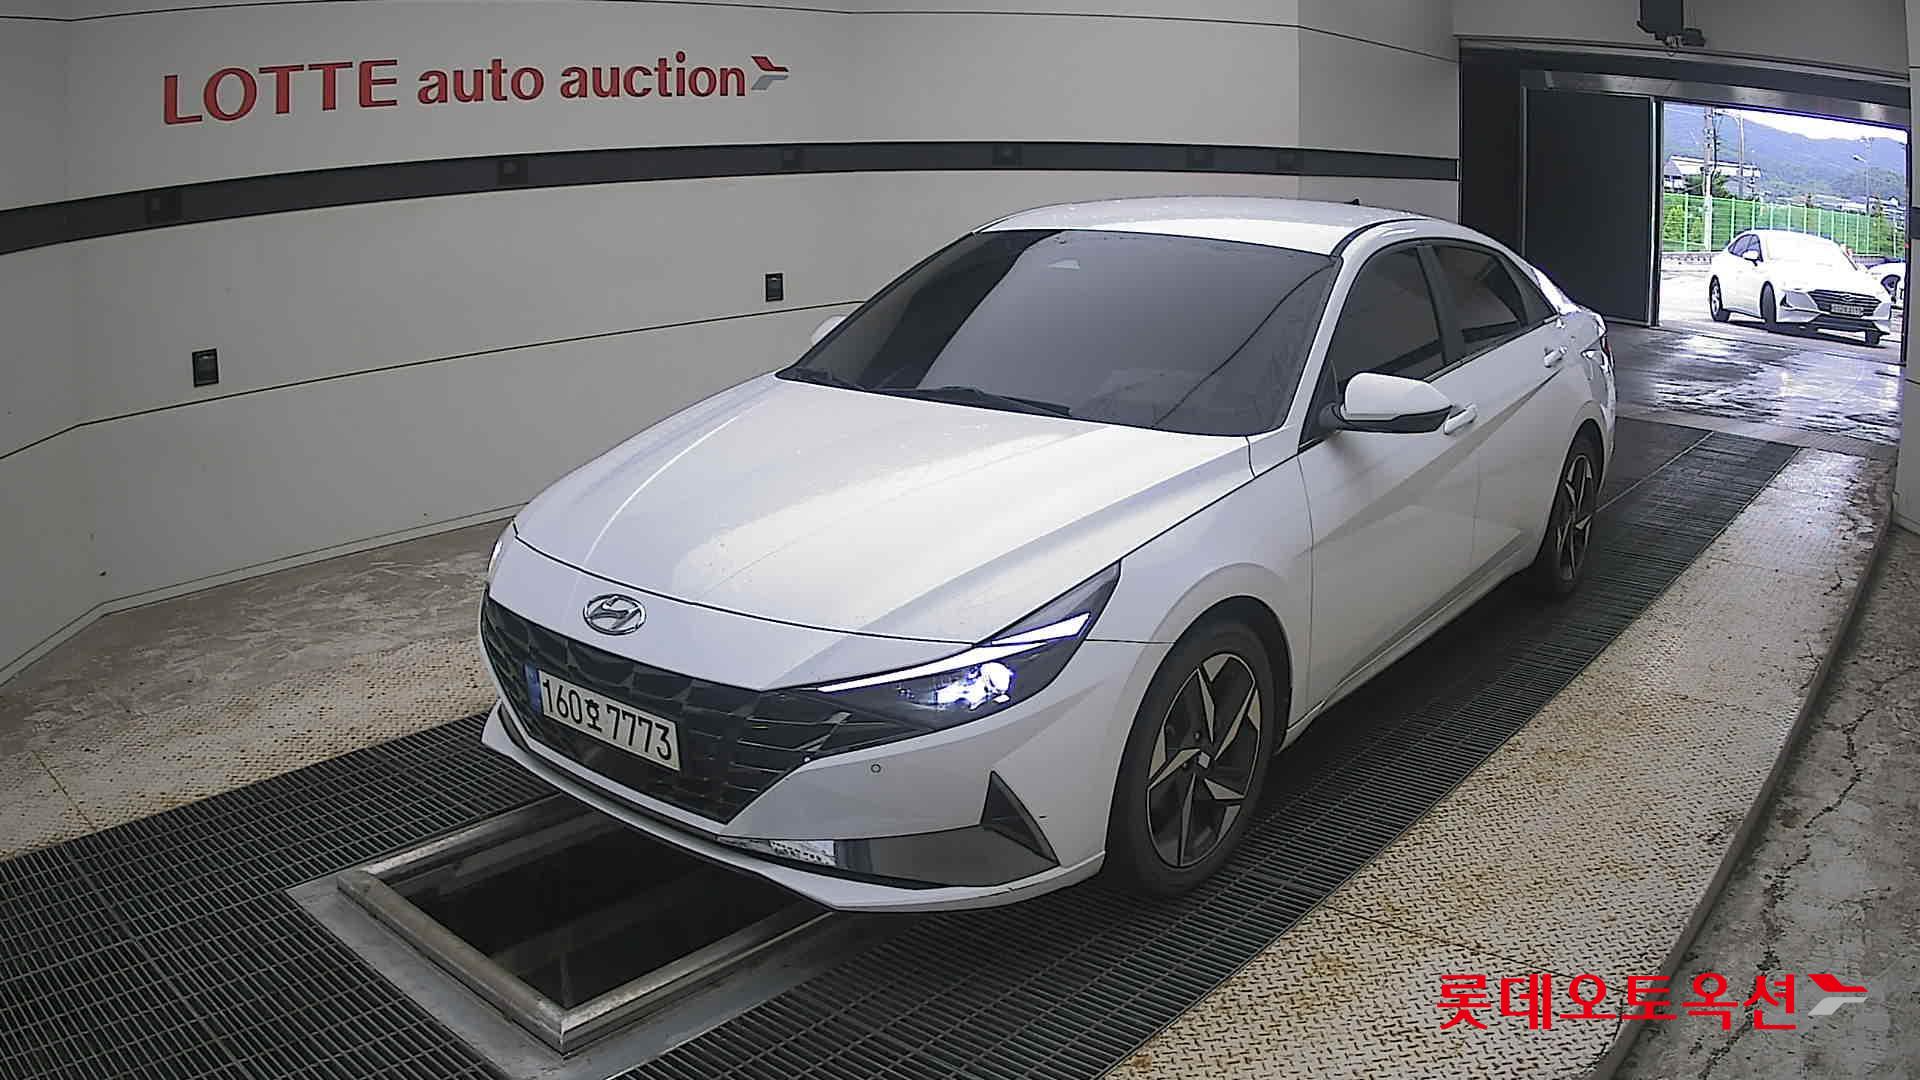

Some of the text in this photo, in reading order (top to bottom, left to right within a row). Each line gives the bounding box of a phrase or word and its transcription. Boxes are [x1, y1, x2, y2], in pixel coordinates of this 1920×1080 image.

[163, 51, 747, 125] LOTTE auto auction
